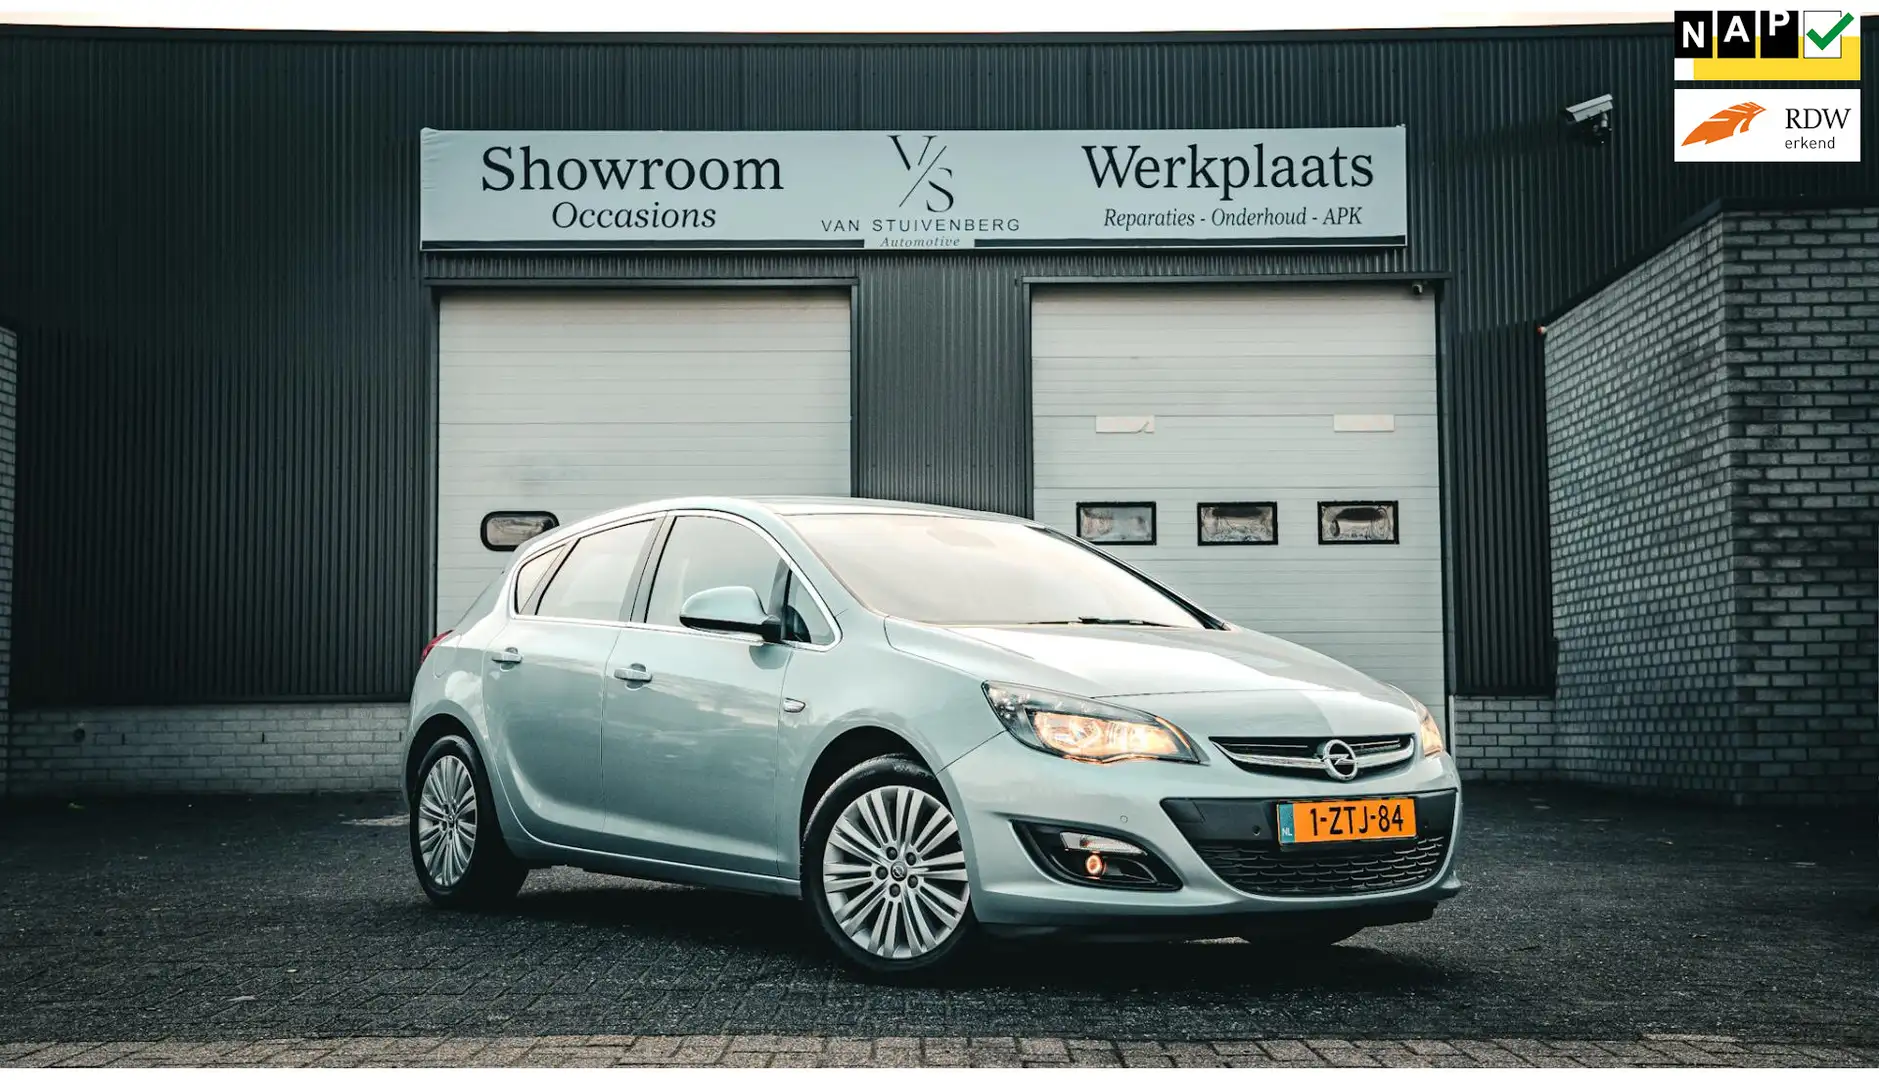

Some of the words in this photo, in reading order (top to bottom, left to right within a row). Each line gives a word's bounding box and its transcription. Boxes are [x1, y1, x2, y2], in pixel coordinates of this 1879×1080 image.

[482, 145, 784, 192] Showroom
[1081, 143, 1374, 201] Werkplaats
[552, 201, 716, 229] Occasions
[821, 218, 860, 232] VAN
[872, 218, 1020, 232] STUIVENBERG
[1103, 207, 1195, 231] Reparaties
[1211, 206, 1307, 226] Onderhoud
[1322, 206, 1363, 225] APK
[880, 235, 960, 248] Automotive
[1281, 827, 1293, 837] NL
[1310, 804, 1404, 836] 1-ZTJ-84
